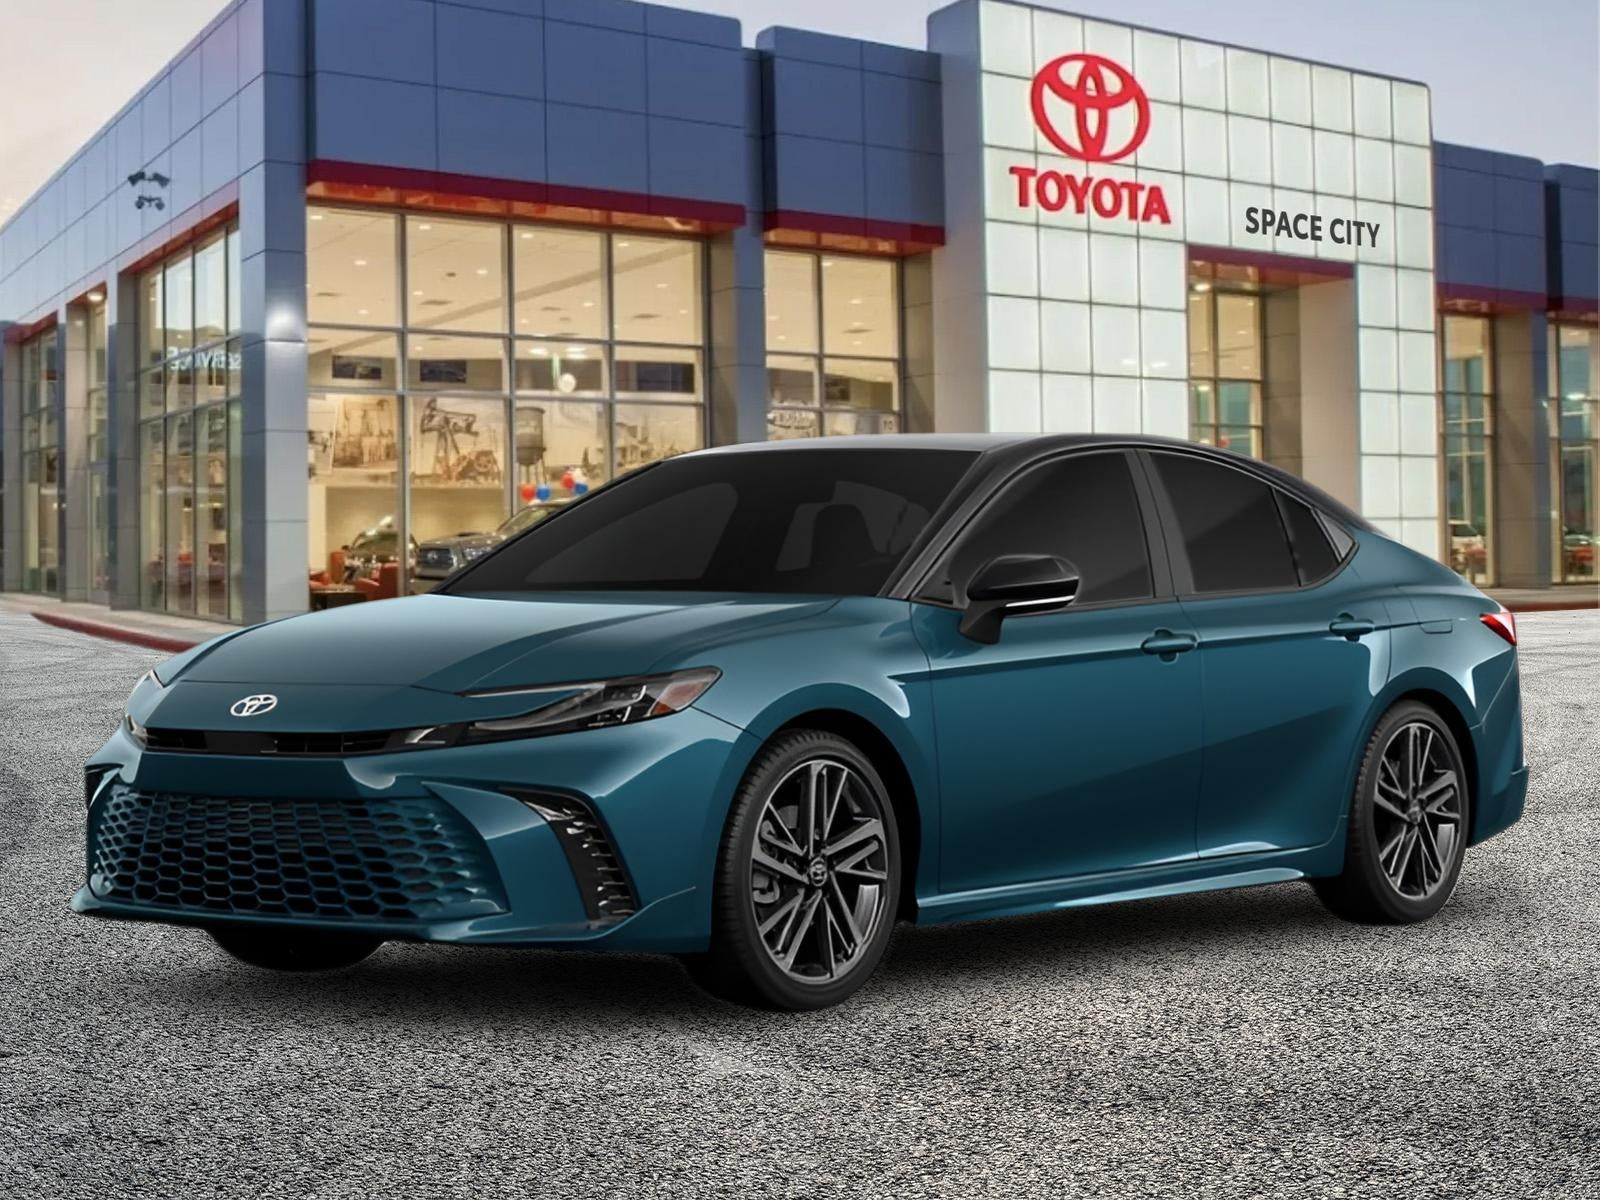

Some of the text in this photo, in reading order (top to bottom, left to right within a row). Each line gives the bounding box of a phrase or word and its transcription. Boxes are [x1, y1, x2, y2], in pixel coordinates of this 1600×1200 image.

[1009, 166, 1171, 224] TOYOTA
[1245, 206, 1381, 248] SPACE CITY
